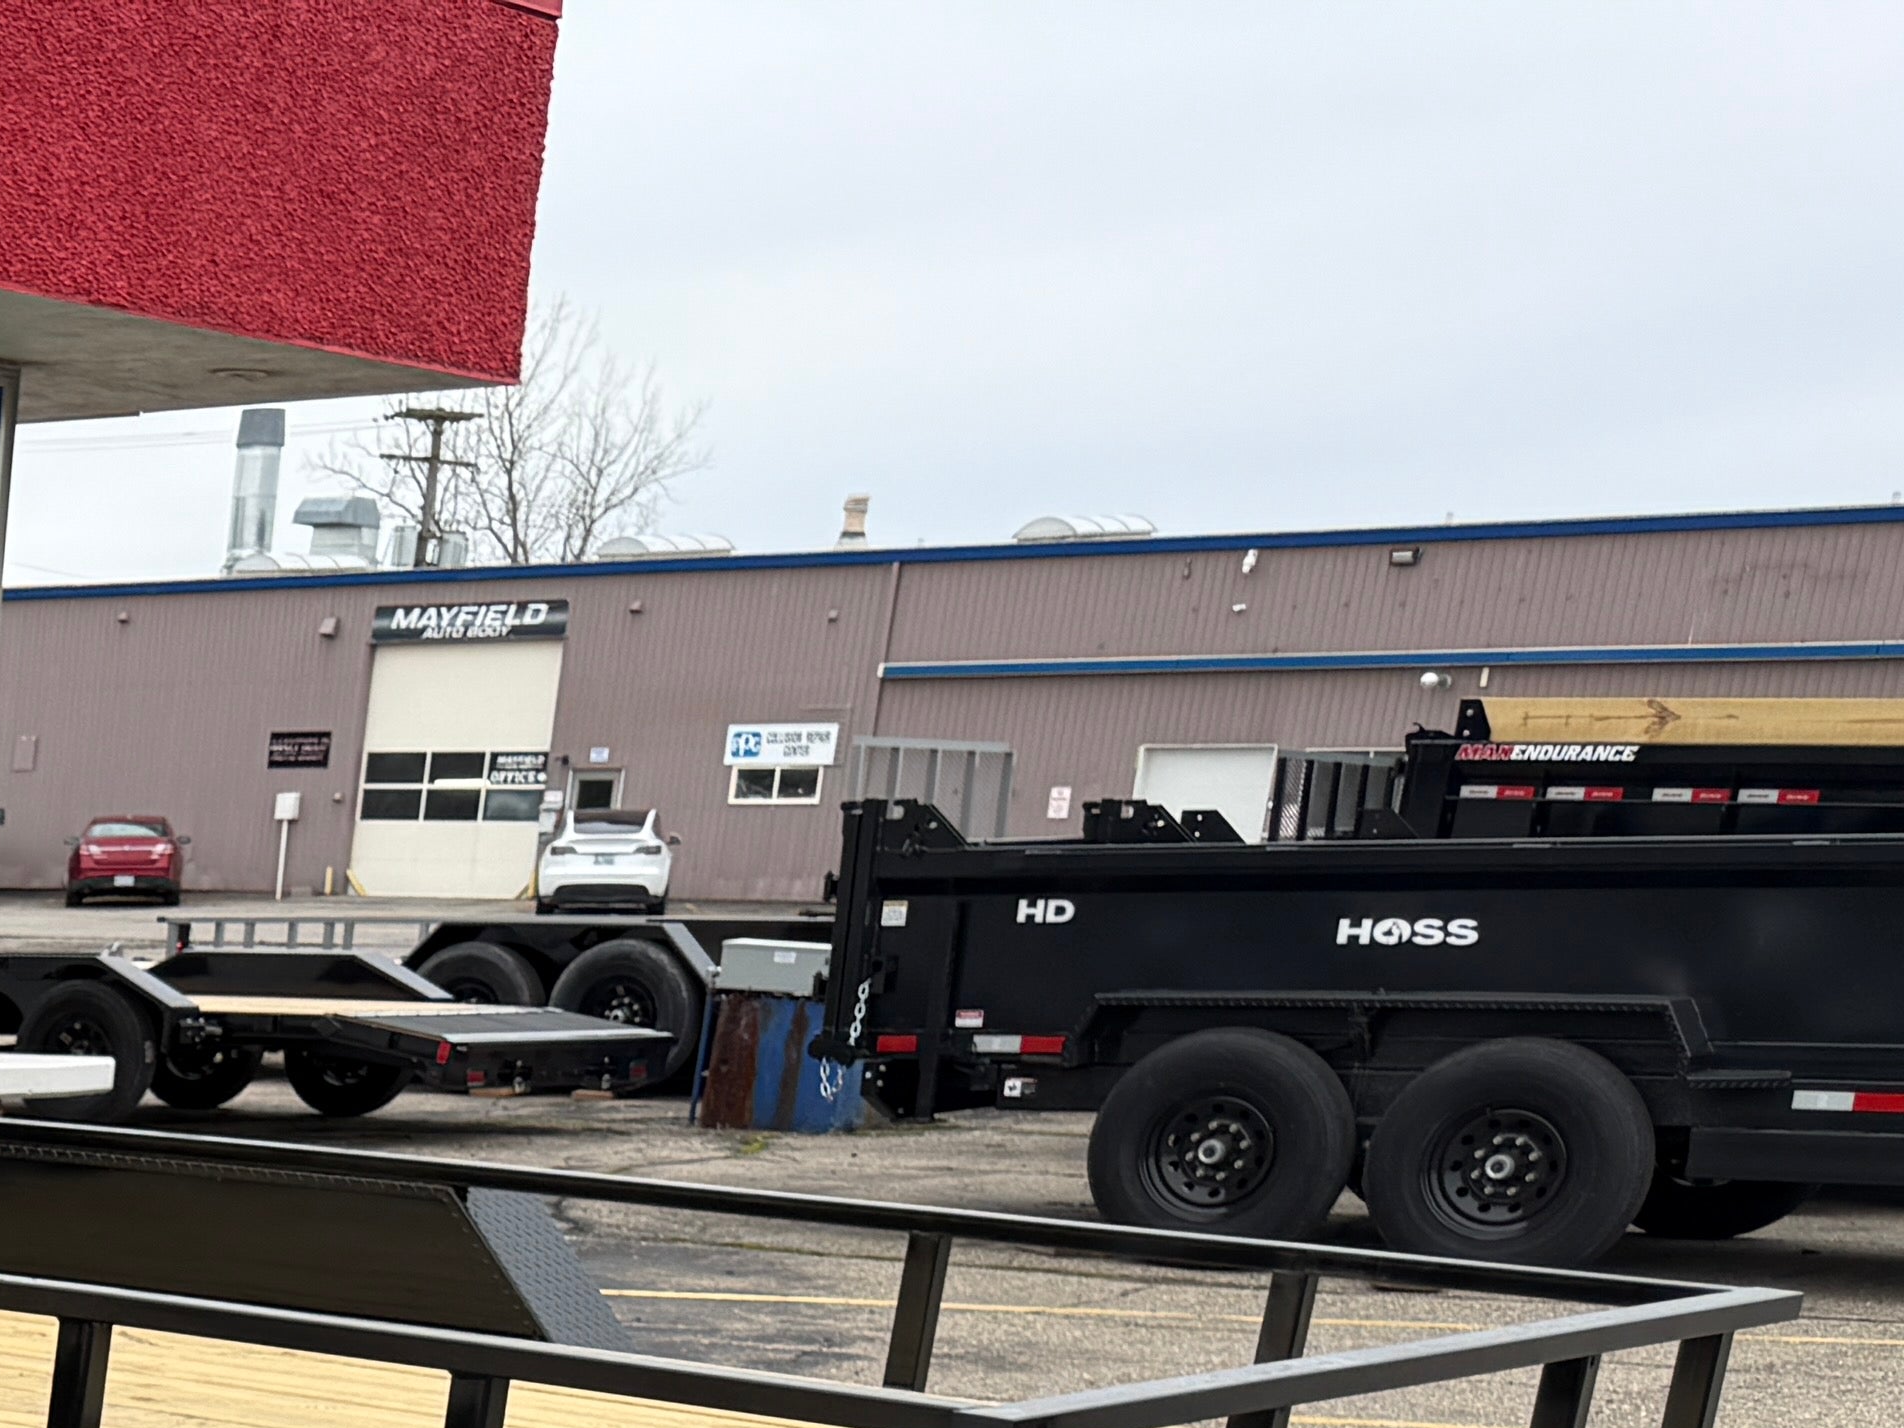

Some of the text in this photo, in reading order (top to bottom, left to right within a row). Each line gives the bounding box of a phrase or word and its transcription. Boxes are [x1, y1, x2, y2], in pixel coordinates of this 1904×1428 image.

[392, 603, 550, 630] MAYFIELD
[423, 624, 513, 640] AUTO BODY
[1016, 898, 1076, 924] HD
[1336, 917, 1480, 947] HOSS
